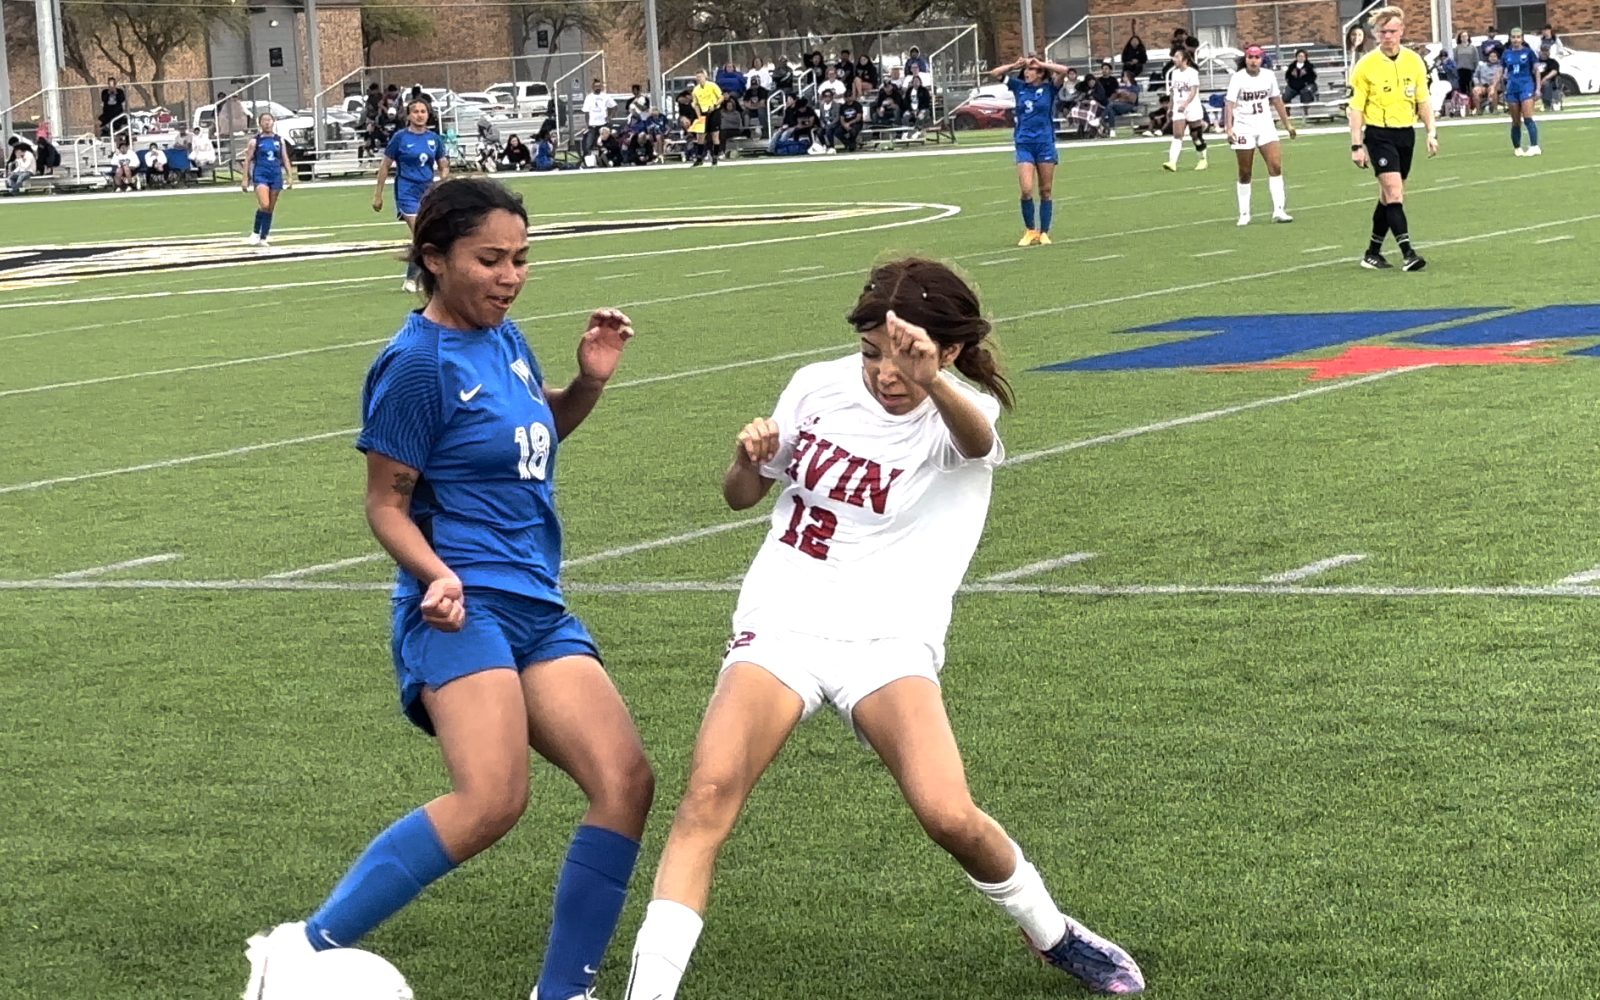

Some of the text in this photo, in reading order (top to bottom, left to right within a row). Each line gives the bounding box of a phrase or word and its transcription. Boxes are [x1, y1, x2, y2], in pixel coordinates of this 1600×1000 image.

[1024, 99, 1034, 114] 3
[1252, 102, 1264, 115] 15
[266, 150, 276, 161] 2
[419, 152, 429, 167] 9
[514, 421, 551, 481] 18
[785, 430, 905, 515] RVIN
[778, 494, 838, 561] 12
[729, 631, 757, 650] 2
